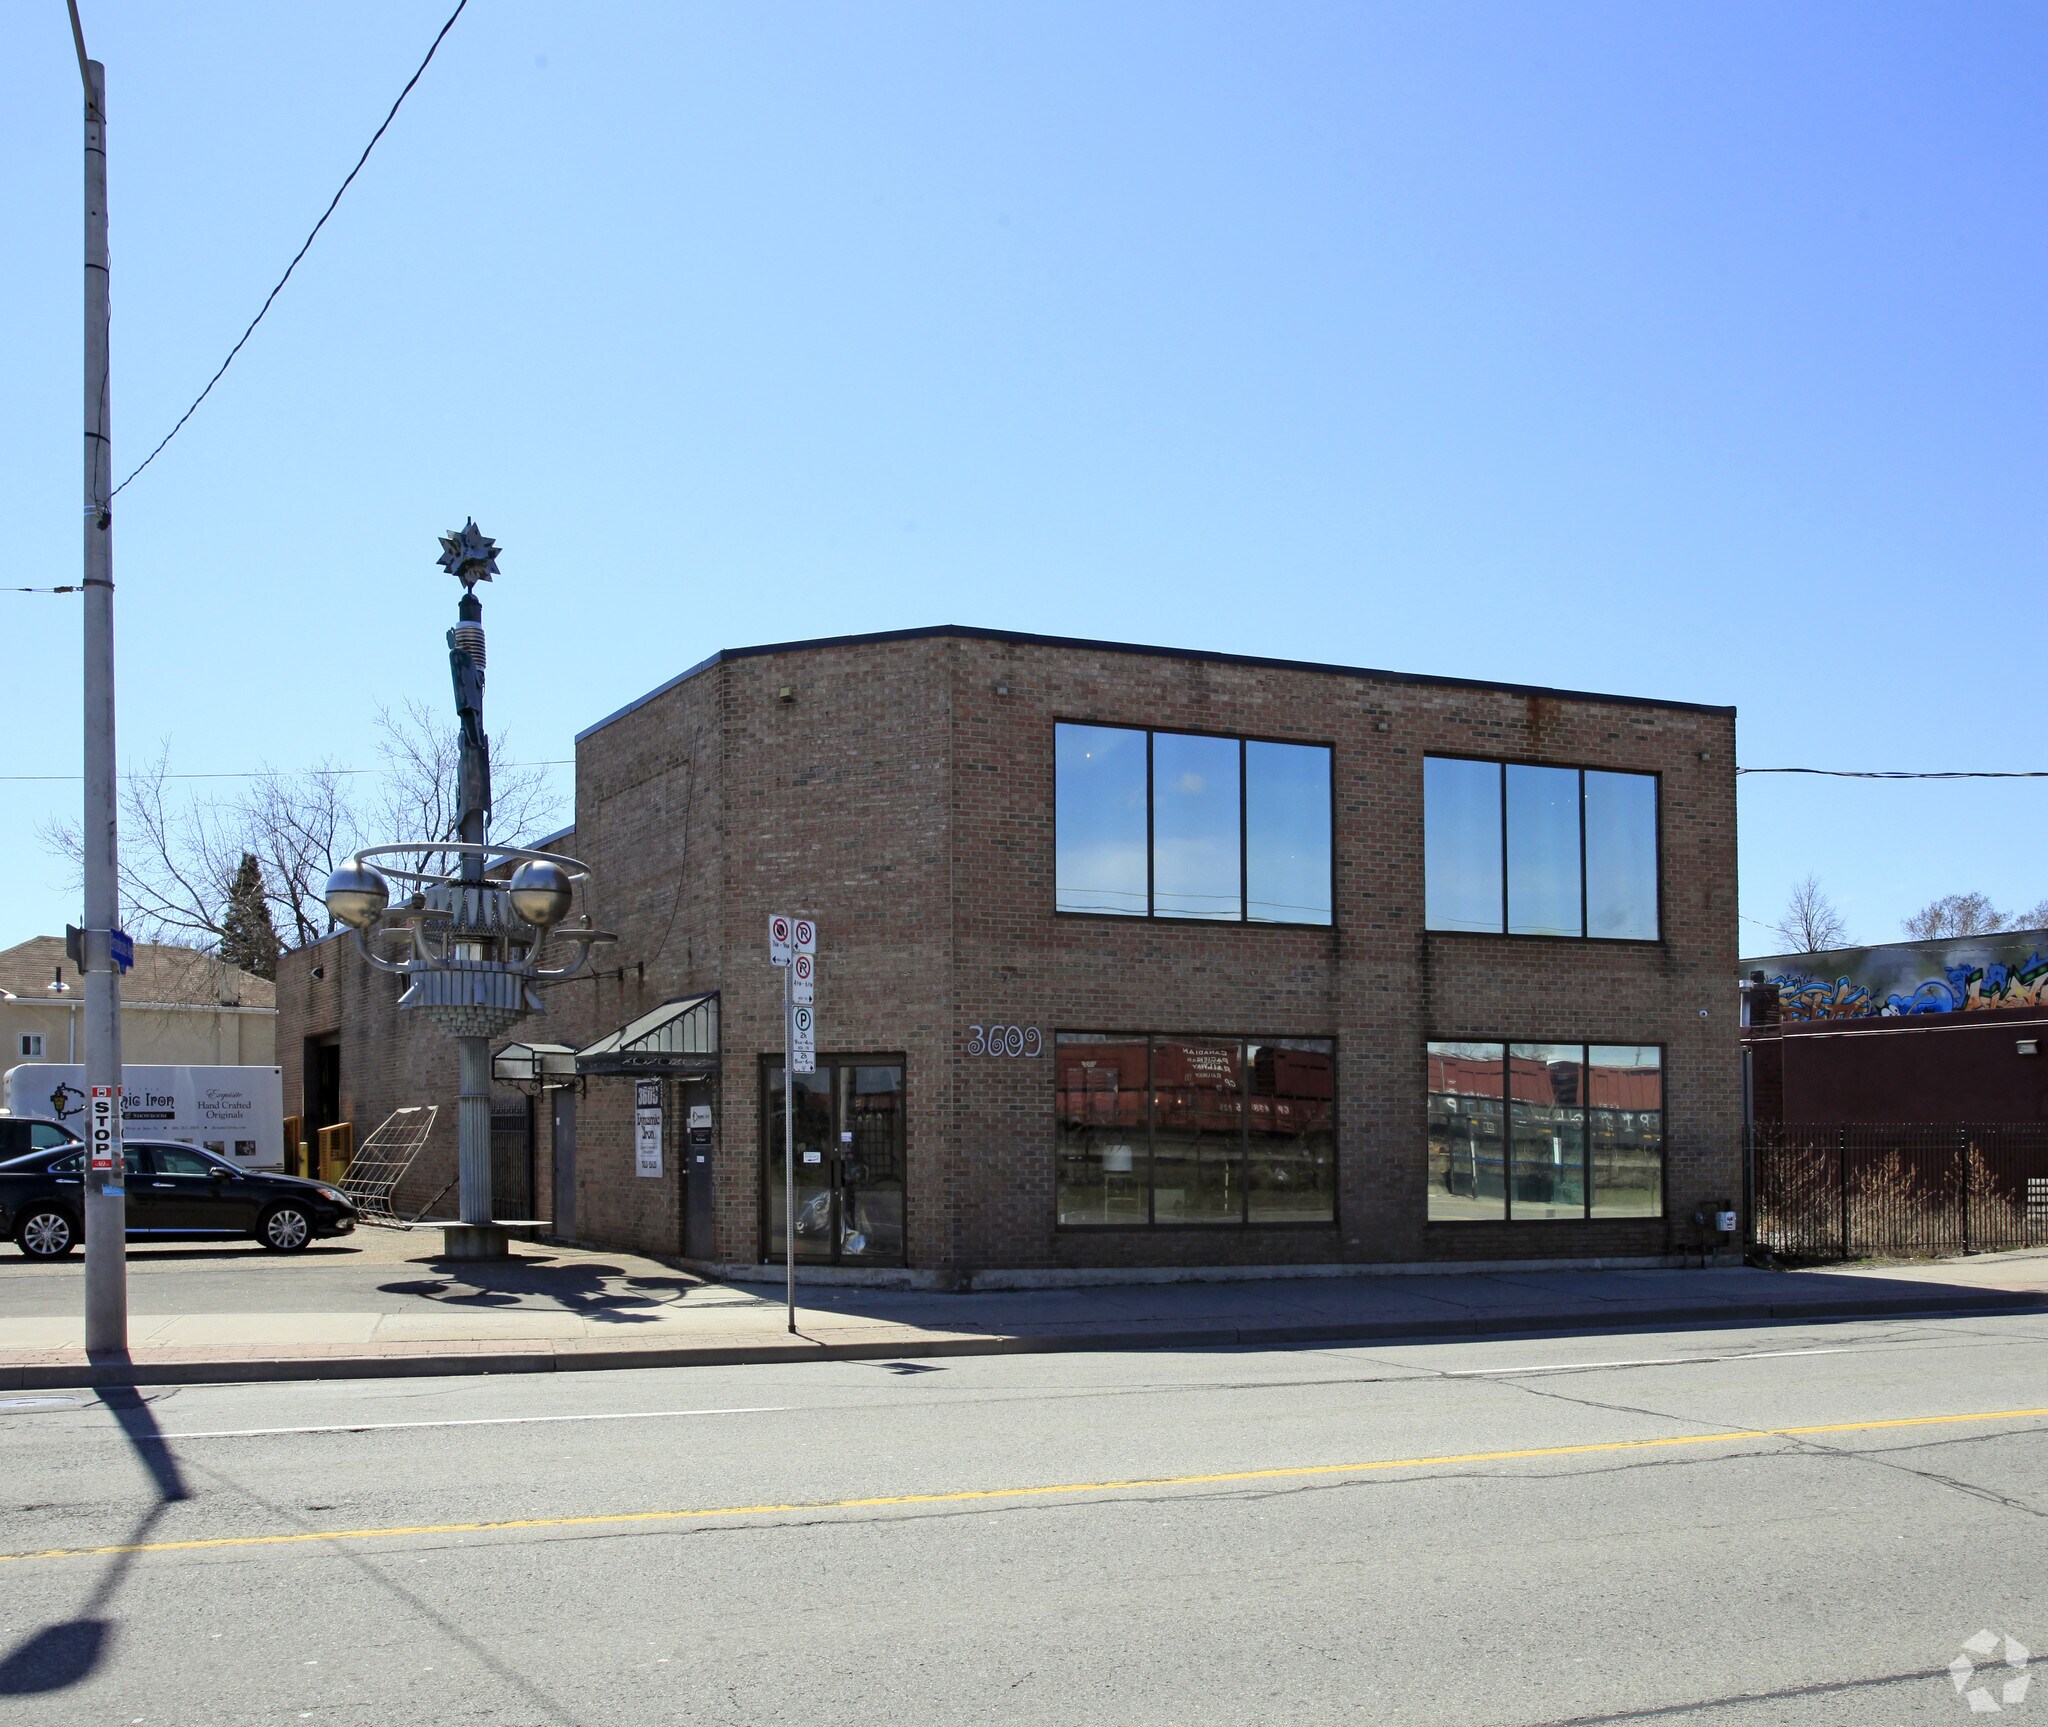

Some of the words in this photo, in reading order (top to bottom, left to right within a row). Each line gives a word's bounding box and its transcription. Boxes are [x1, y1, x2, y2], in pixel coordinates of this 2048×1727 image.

[967, 1025, 1042, 1057] 3609
[146, 1093, 175, 1109] Iron
[206, 1089, 242, 1101] Exquisite
[198, 1101, 220, 1109] Hand
[222, 1101, 251, 1109] Crafted
[206, 1110, 243, 1120] Originals
[95, 1102, 110, 1154] STOP
